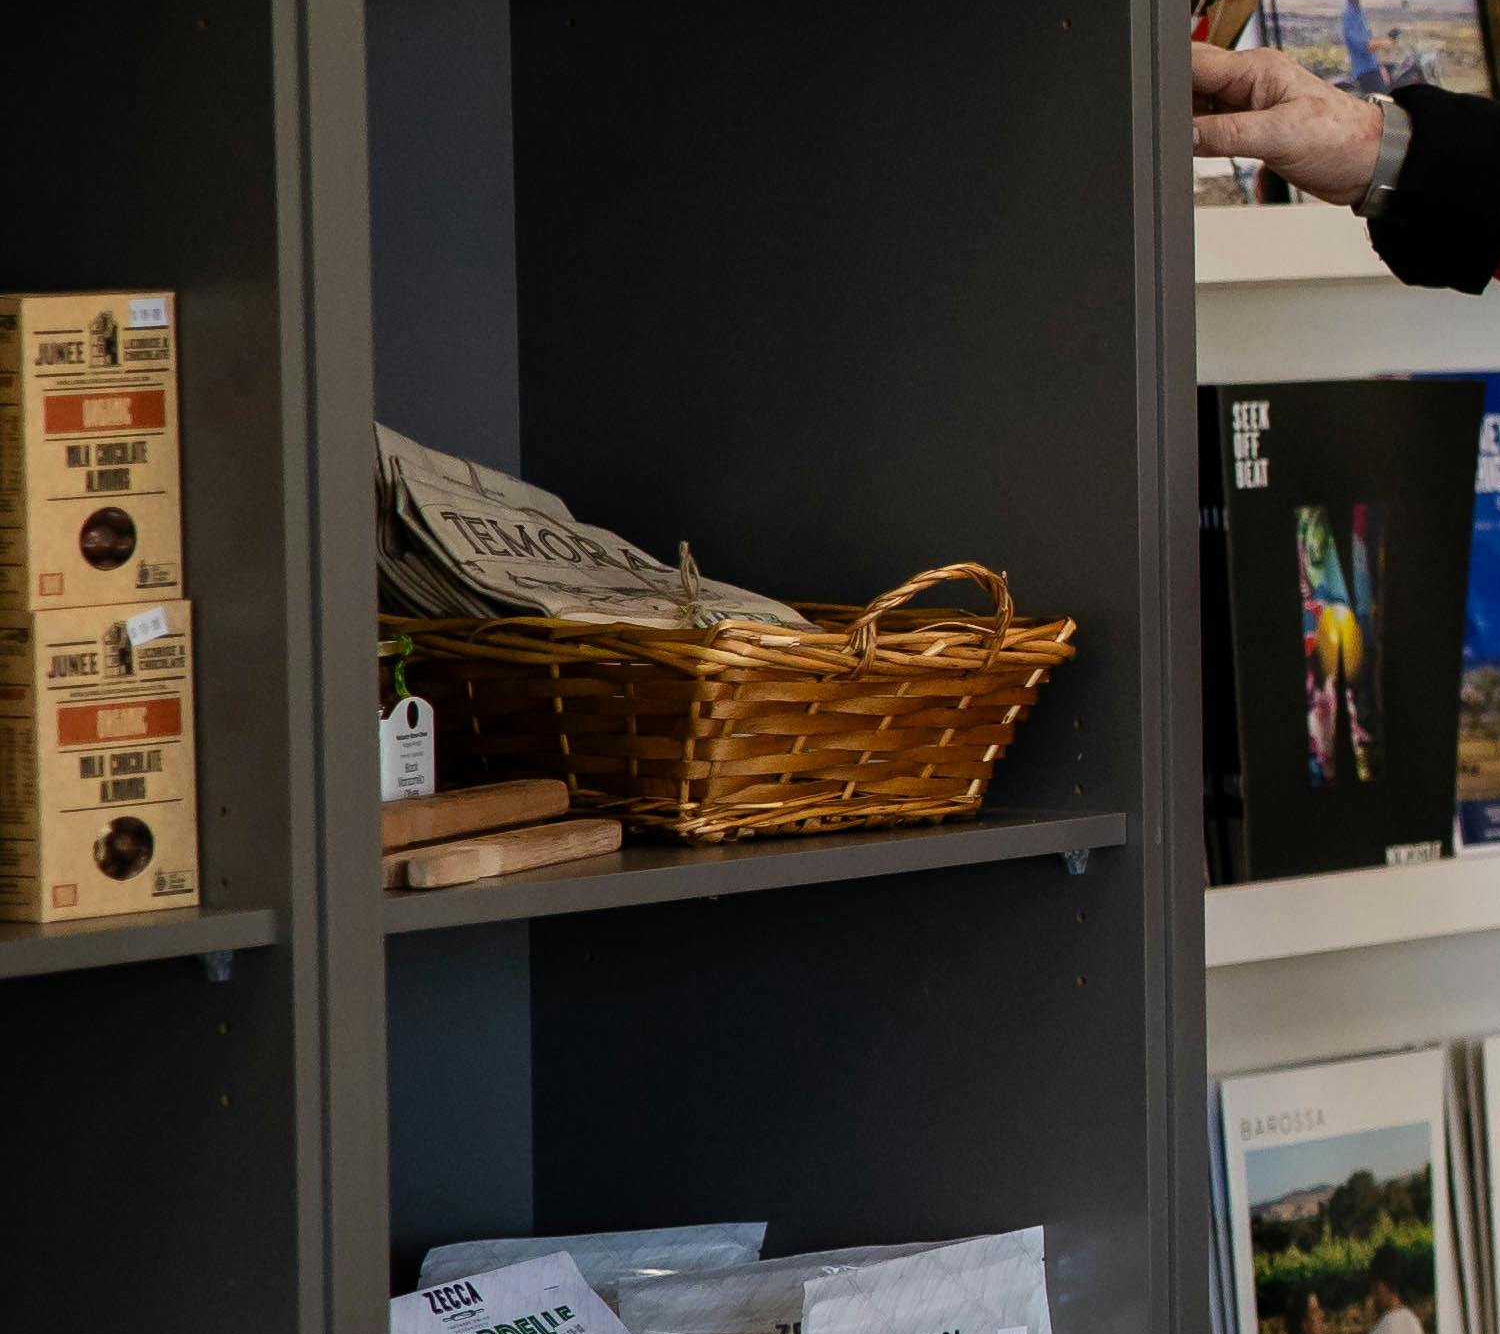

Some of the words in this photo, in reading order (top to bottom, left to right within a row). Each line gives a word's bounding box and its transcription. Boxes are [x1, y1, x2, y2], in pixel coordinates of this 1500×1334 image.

[34, 340, 86, 366] JUNEE
[48, 652, 99, 678] JUNEE
[1239, 1107, 1327, 1143] BAROSSA
[422, 1281, 483, 1315] ZECCA
